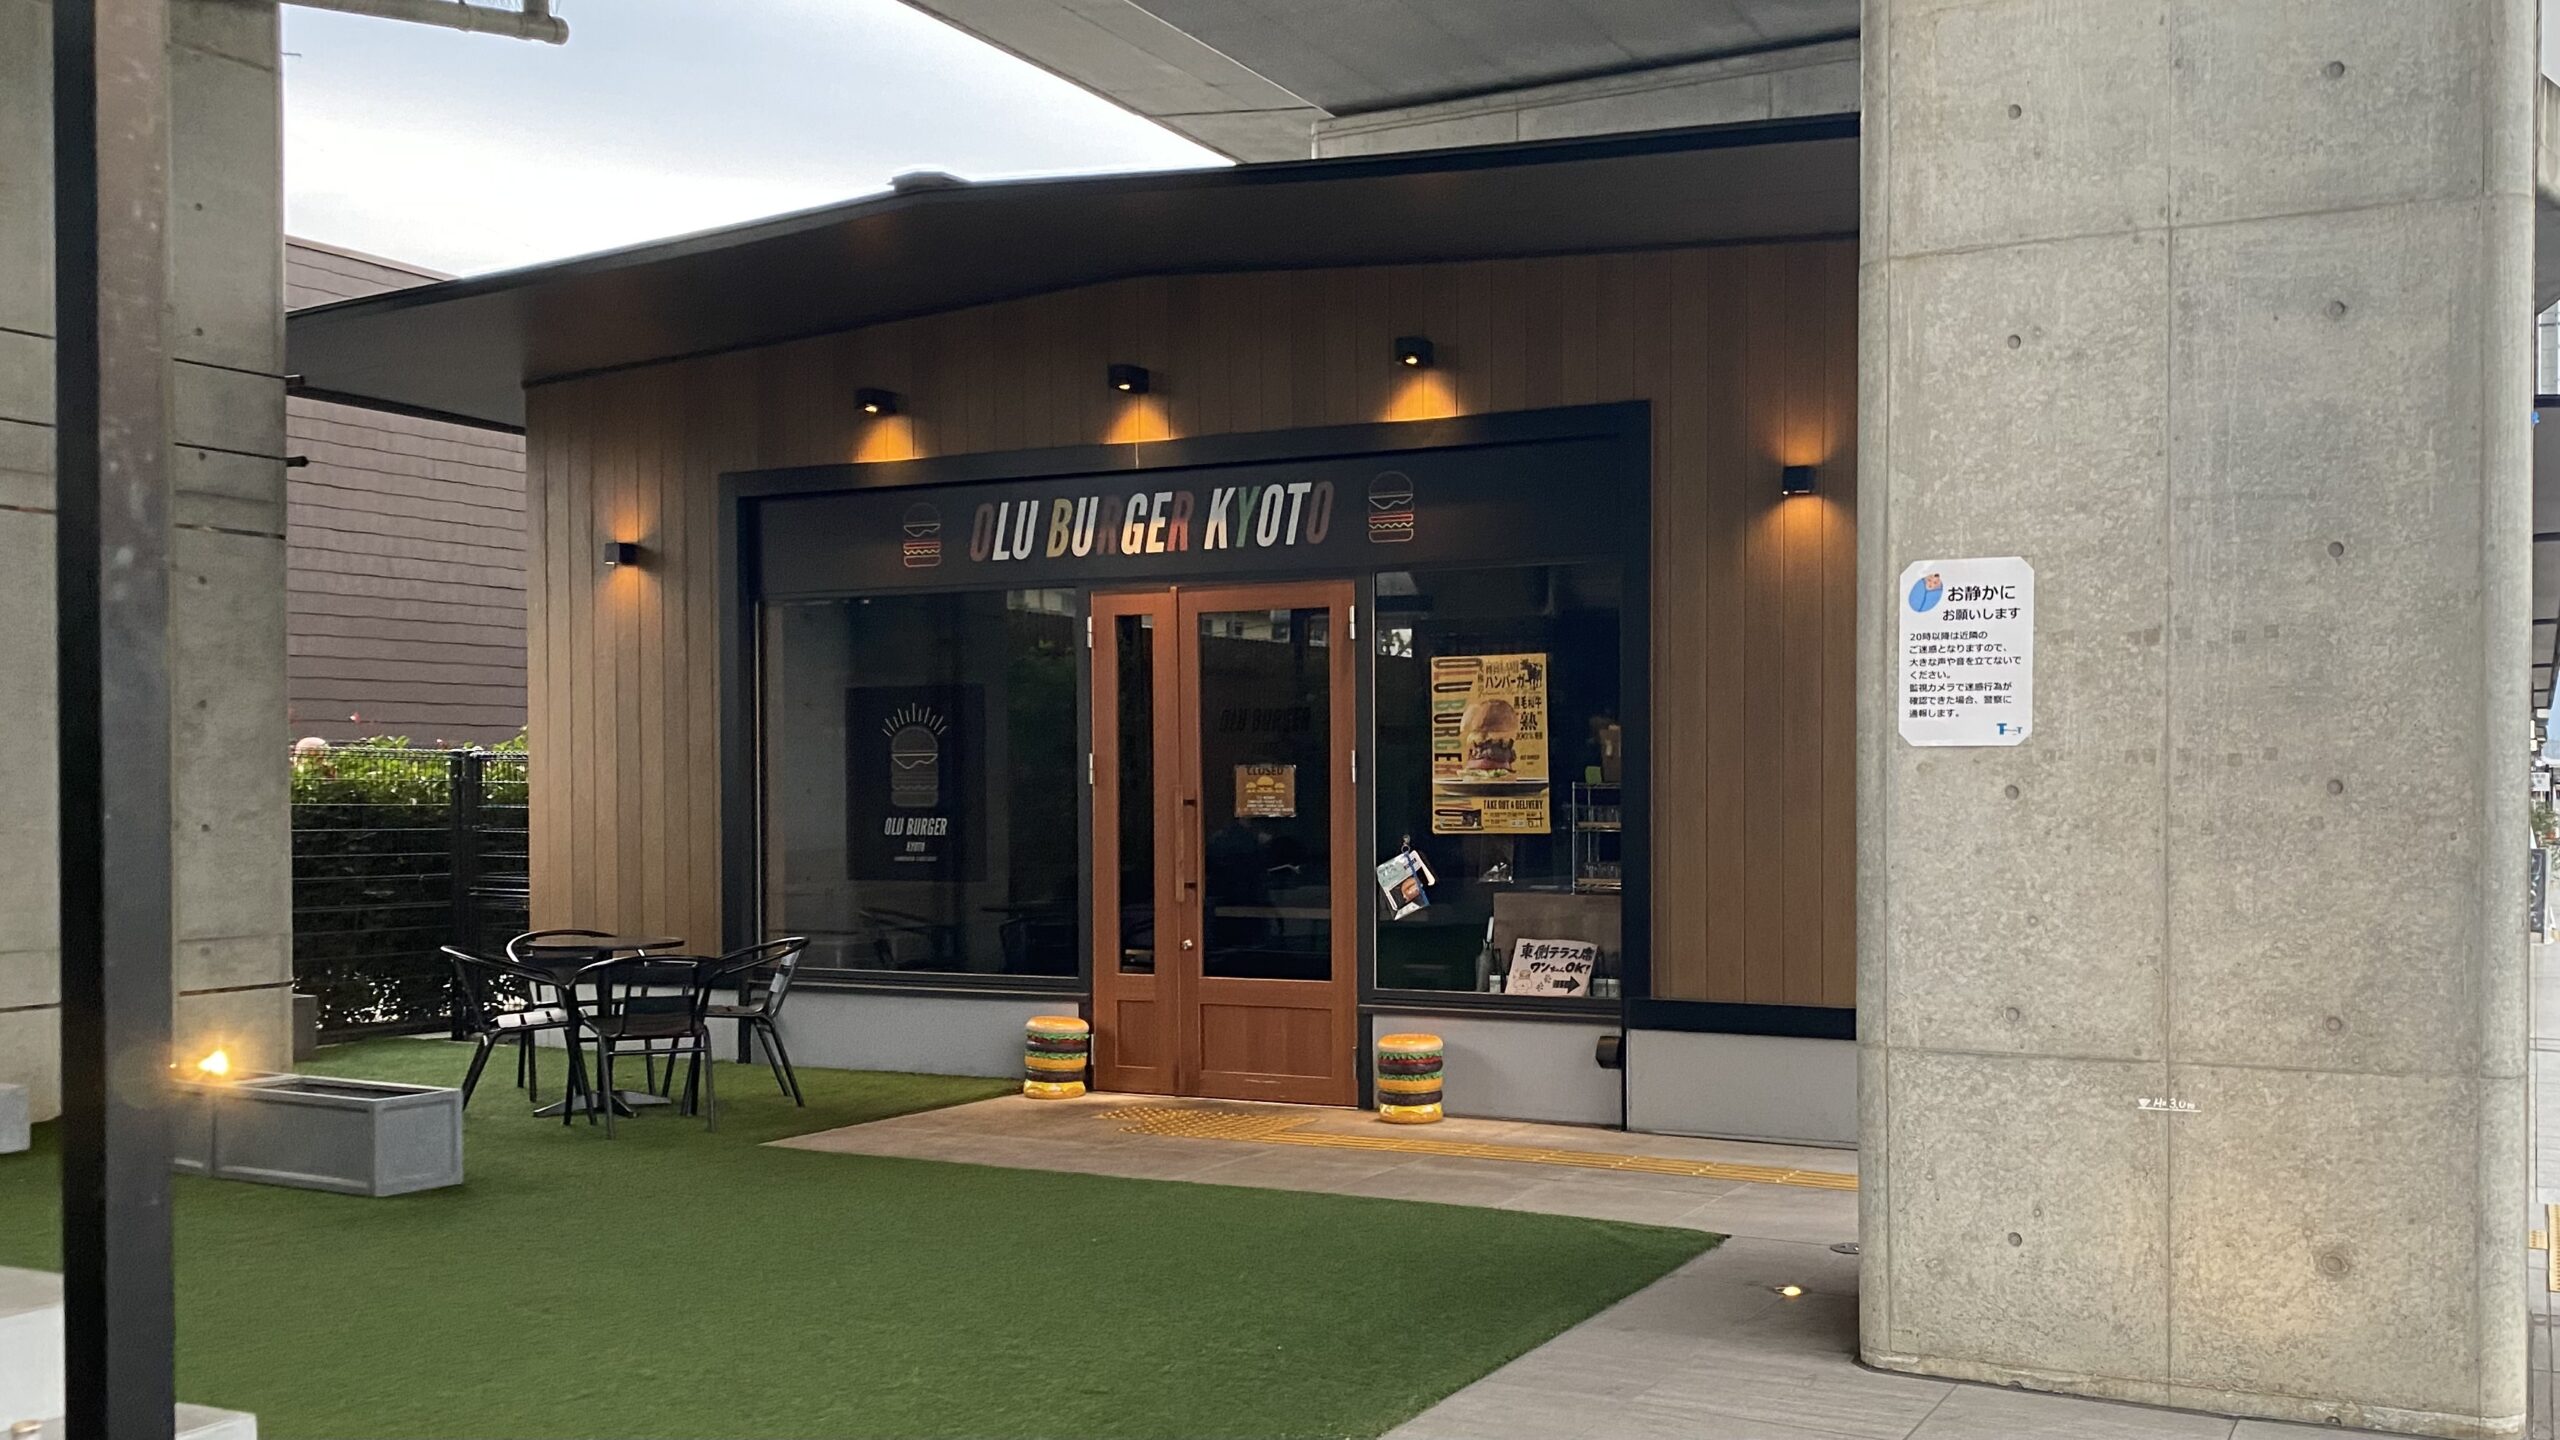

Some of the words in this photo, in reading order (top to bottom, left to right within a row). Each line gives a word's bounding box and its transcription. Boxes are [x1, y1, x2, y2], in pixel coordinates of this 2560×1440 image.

[970, 499, 1039, 562] OLU
[1046, 490, 1195, 558] BURGER
[1204, 480, 1335, 551] KYOTO
[1947, 584, 2016, 602] お静かに
[1942, 607, 2021, 621] お願いします
[1909, 630, 1988, 641] 20時以降は近隣の
[1909, 643, 2007, 654] ご迷惑となりますので、
[1909, 656, 2022, 667] 大きな声や音を立てないで
[1909, 670, 1951, 680] ください。
[1485, 673, 1530, 689] ハンバーガー
[1909, 681, 2012, 693] 監視カメラで迷惑行為が
[1909, 695, 2012, 706] 確認できた場合、警察に
[1909, 708, 1960, 718] 通報します。
[1247, 767, 1284, 775] CLOSED
[1484, 799, 1498, 809] TAKE
[1515, 799, 1543, 809] DELIVERY
[906, 817, 948, 836] BURGER
[1520, 943, 1595, 961] 東側テラス席
